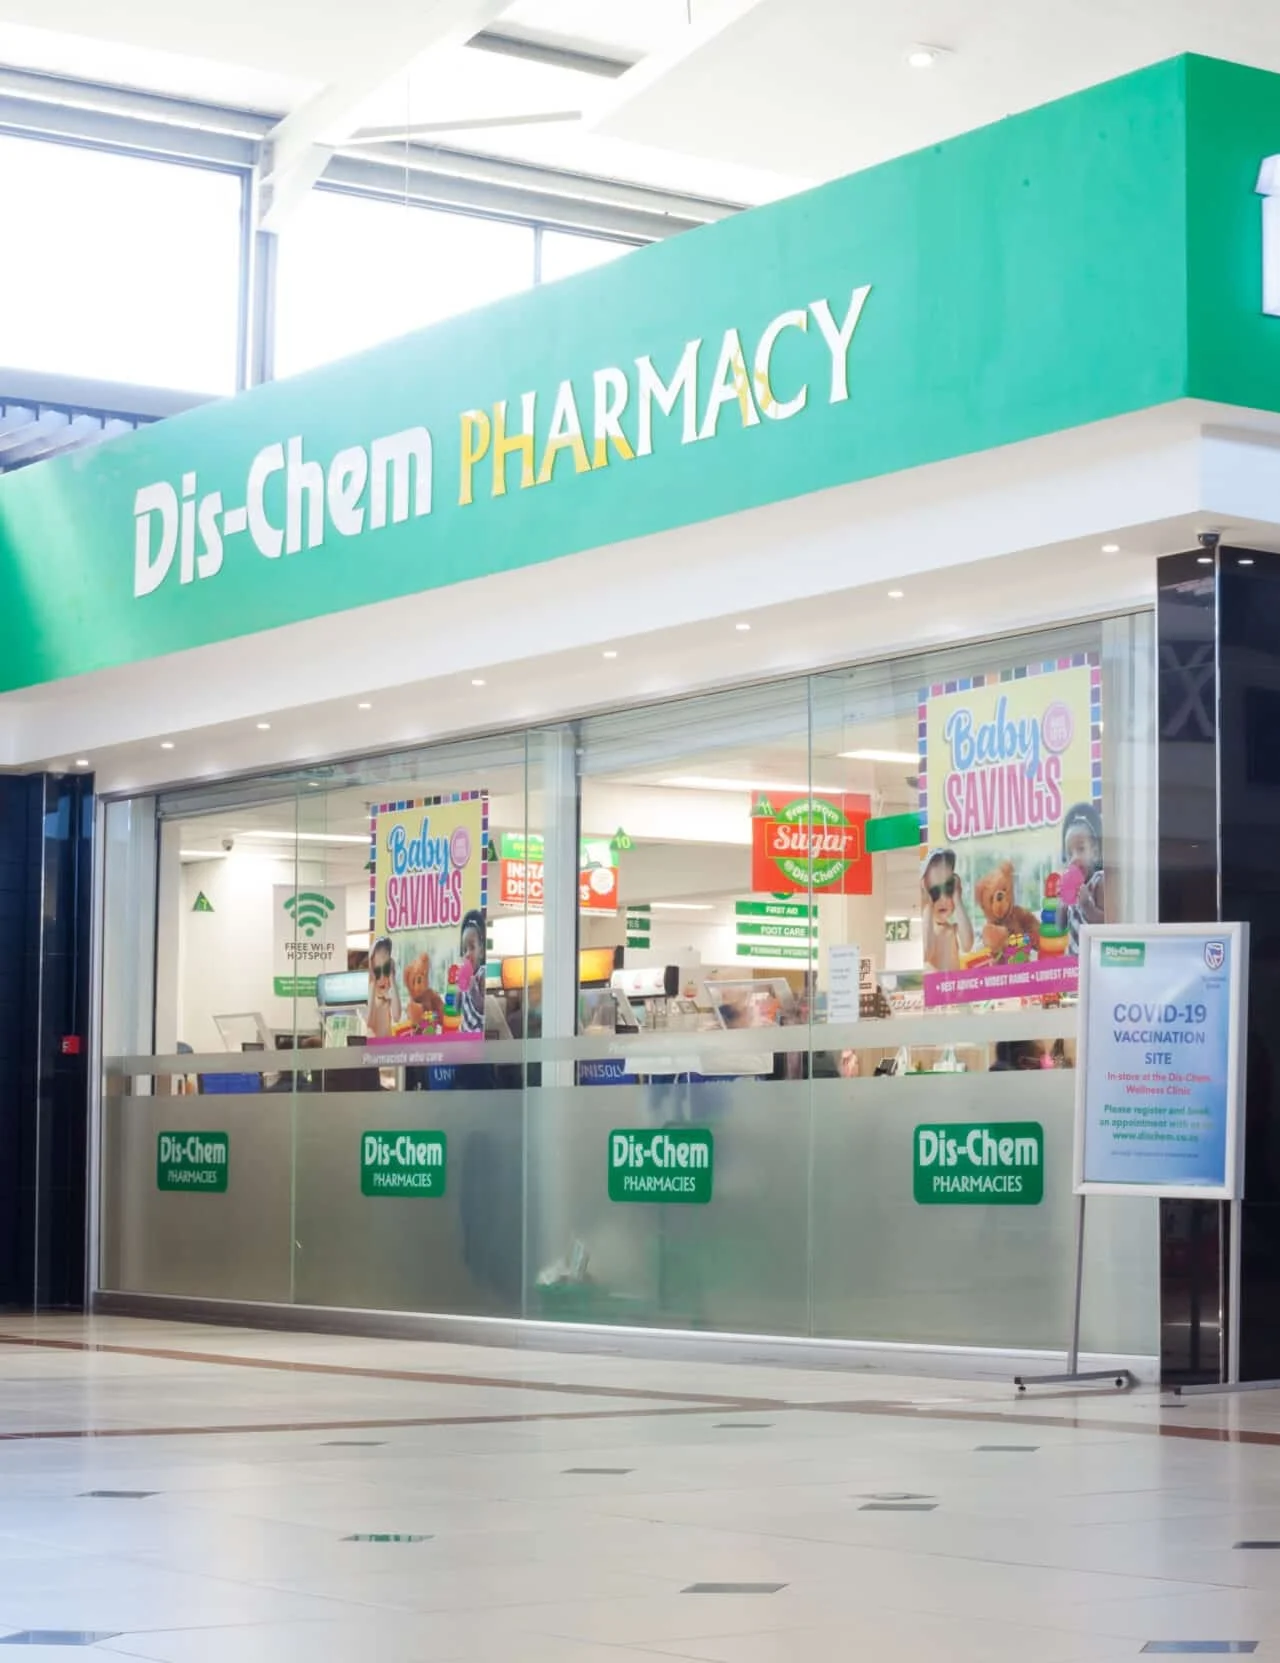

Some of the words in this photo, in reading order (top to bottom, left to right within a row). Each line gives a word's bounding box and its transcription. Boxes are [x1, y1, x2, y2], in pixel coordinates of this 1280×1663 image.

[134, 426, 432, 597] Dis-Chem
[458, 284, 873, 506] PHARMACY
[947, 696, 1040, 779] Baby
[947, 756, 1062, 837] SAVINGS
[617, 836, 631, 849] 10
[773, 825, 853, 858] Sugar
[389, 817, 448, 887] Baby
[388, 870, 461, 929] SAVINGS
[761, 926, 782, 936] FOOT
[784, 927, 808, 937] CARE
[285, 943, 308, 951] FREE
[287, 951, 333, 960] HOTSPOT
[1113, 1003, 1207, 1023] COVID-19
[1113, 1030, 1205, 1044] VACCINATION
[1145, 1052, 1172, 1065] SITE
[1126, 1086, 1164, 1095] Wellness
[1167, 1086, 1191, 1096] Clinic
[160, 1136, 226, 1164] Dis-Chem
[364, 1136, 443, 1166] Dis-Chem
[613, 1135, 709, 1168] Dis-Chem
[919, 1129, 1039, 1166] Dis-Chem
[168, 1169, 217, 1184] PHARMACIES
[373, 1173, 432, 1187] PHARMACIES
[623, 1176, 696, 1192] PHARMACIES
[933, 1176, 1023, 1192] PHARMACIES
